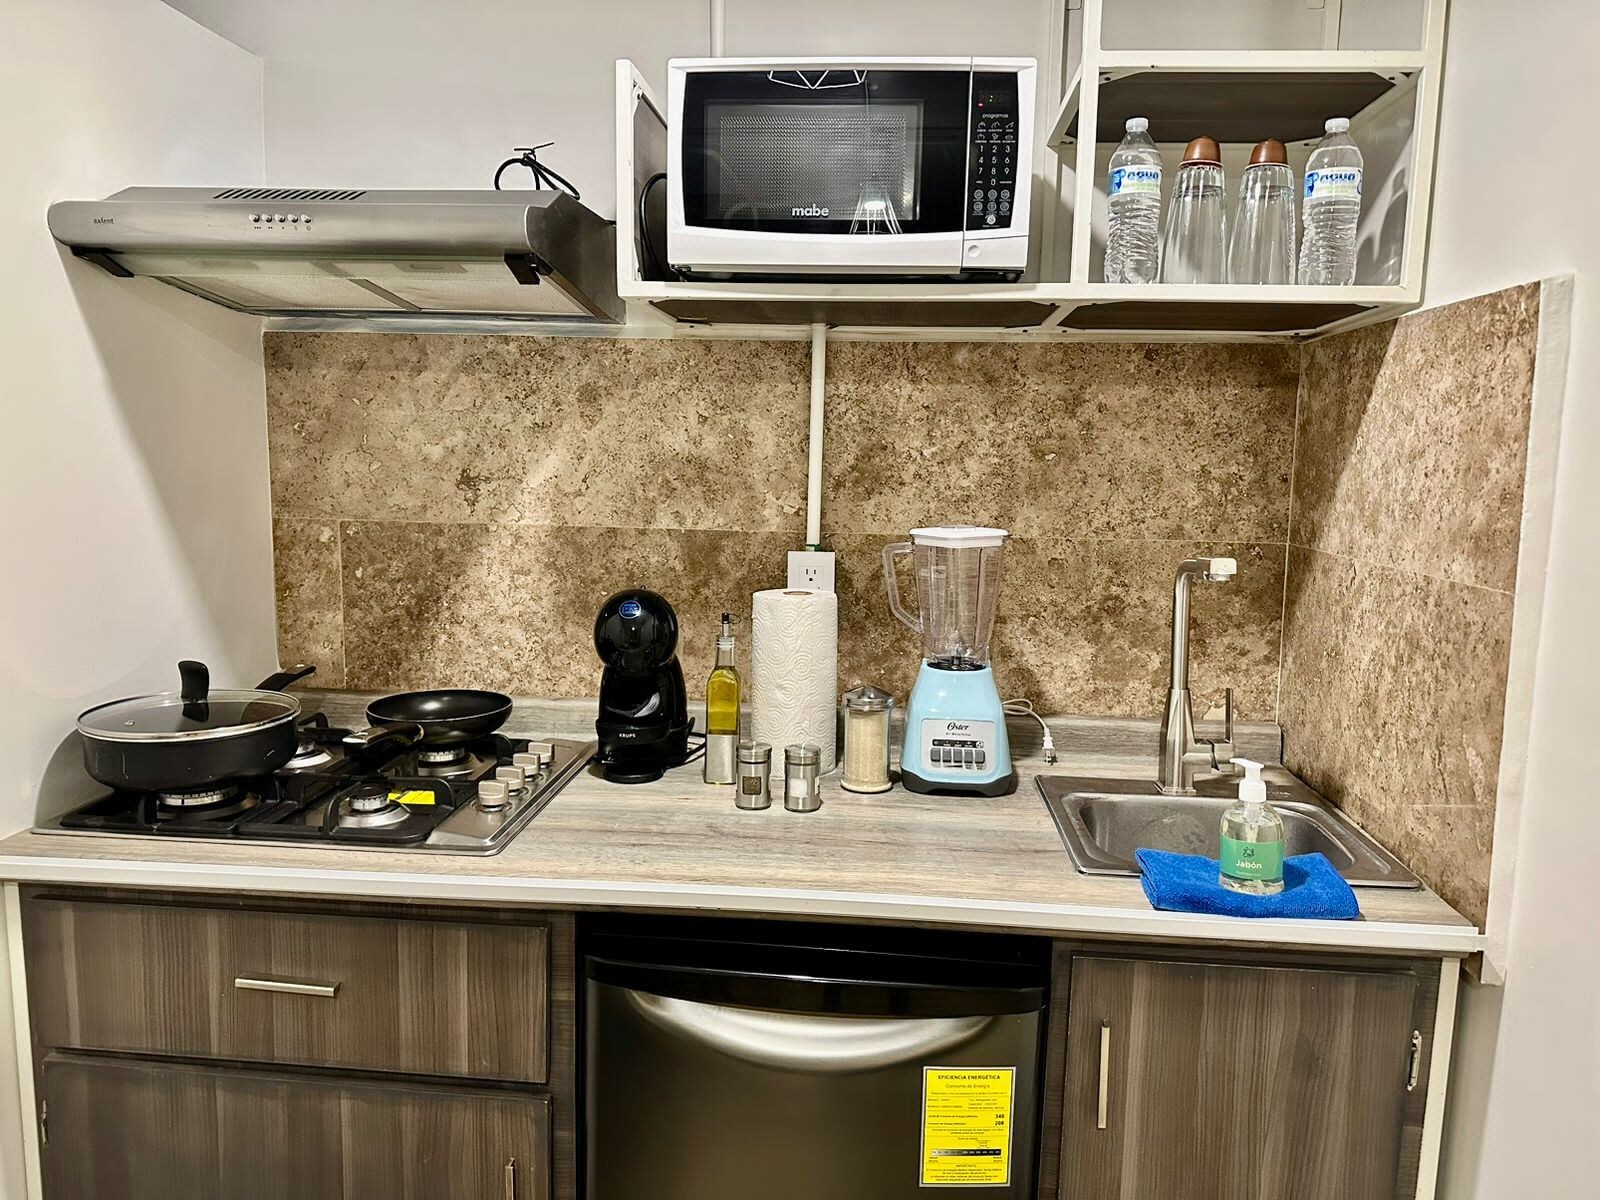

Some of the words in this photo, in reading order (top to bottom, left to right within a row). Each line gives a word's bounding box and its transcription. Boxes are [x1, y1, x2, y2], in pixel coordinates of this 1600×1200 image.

[791, 203, 829, 216] mabe
[947, 722, 969, 731] Oster
[1236, 860, 1262, 869] Jabón
